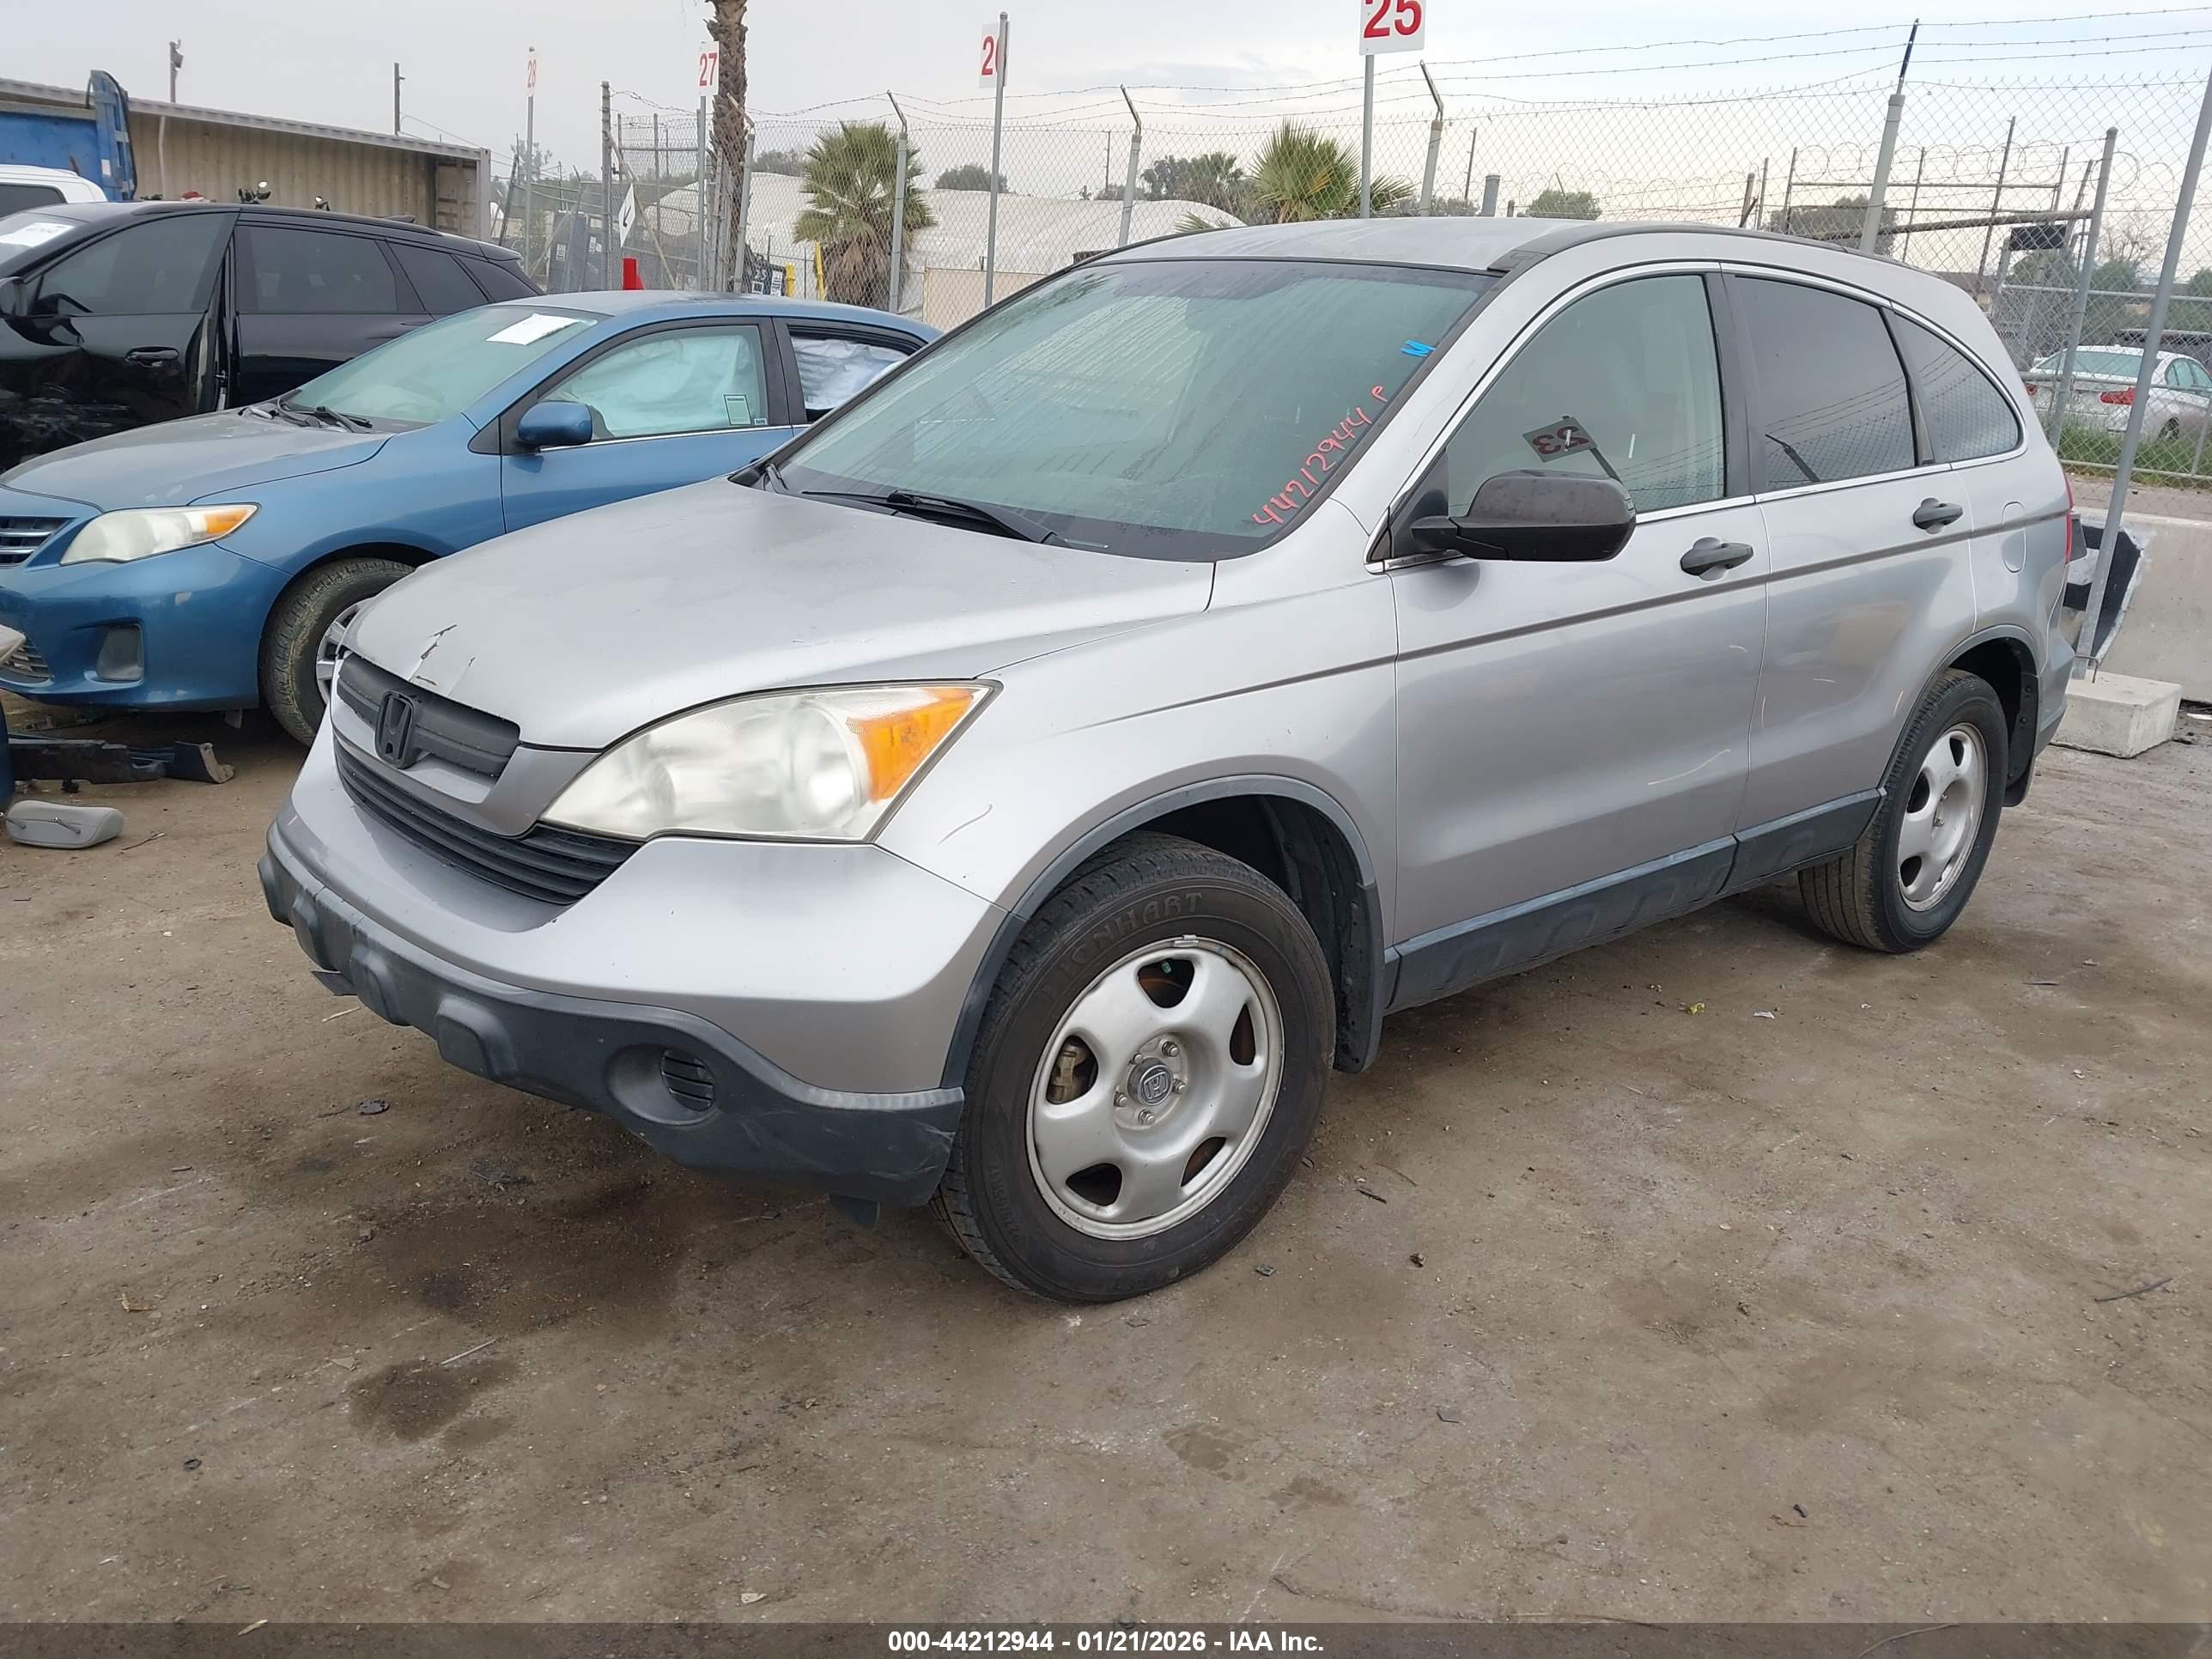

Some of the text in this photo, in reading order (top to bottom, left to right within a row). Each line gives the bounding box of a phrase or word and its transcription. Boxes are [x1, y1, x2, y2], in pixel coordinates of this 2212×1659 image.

[1364, 0, 1422, 38] 25
[699, 52, 718, 86] 27
[981, 35, 1000, 76] 2
[1252, 406, 1373, 525] 44212944
